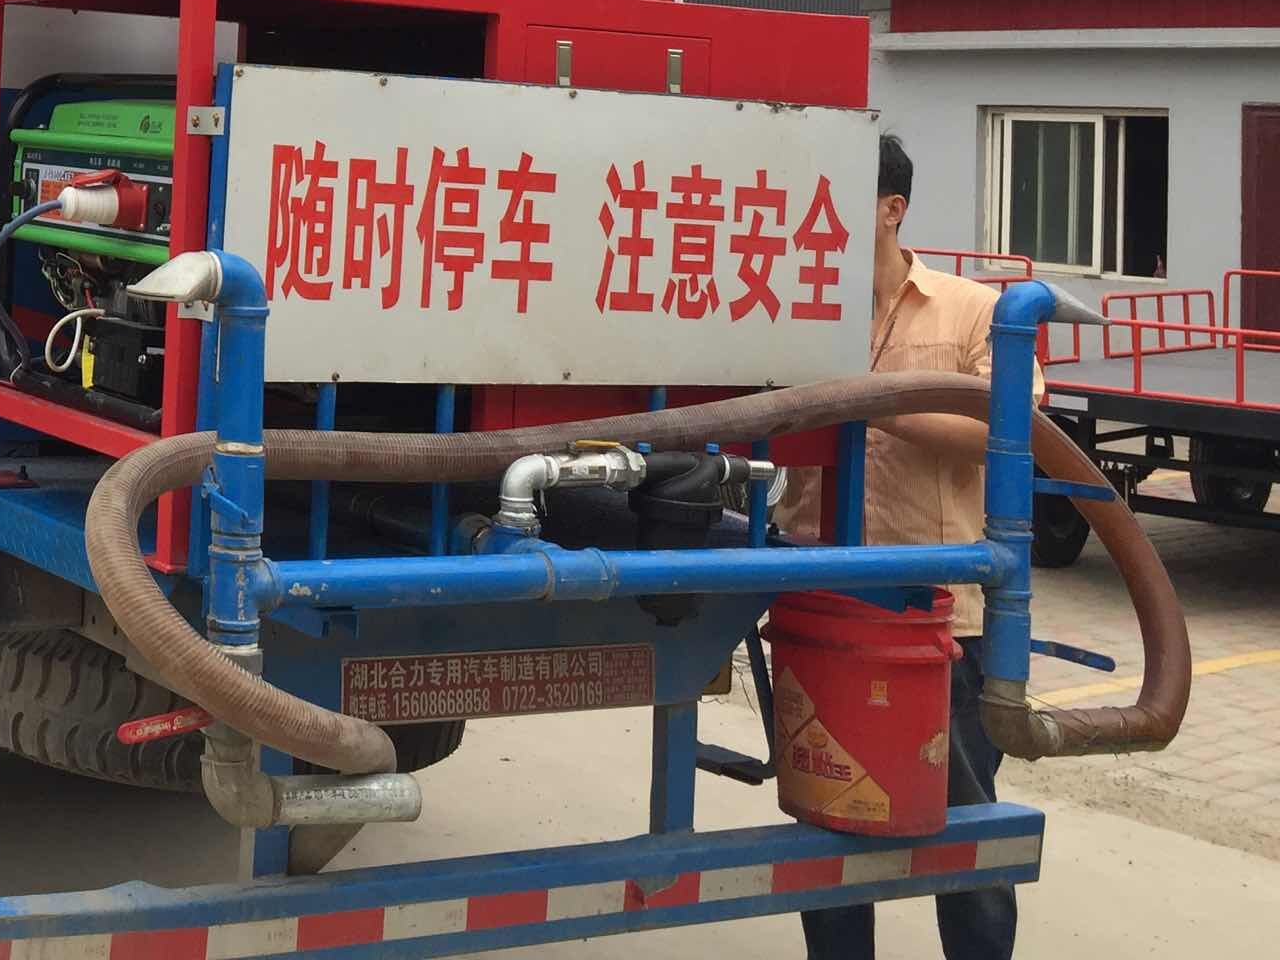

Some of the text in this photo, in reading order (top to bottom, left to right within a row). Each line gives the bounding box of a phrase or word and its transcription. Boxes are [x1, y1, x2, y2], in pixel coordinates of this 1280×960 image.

[265, 140, 851, 324] 随时停车 注意安全
[349, 651, 603, 690] 湖北合力专用汽车制造有限公司
[501, 681, 603, 712] 0722-3520169
